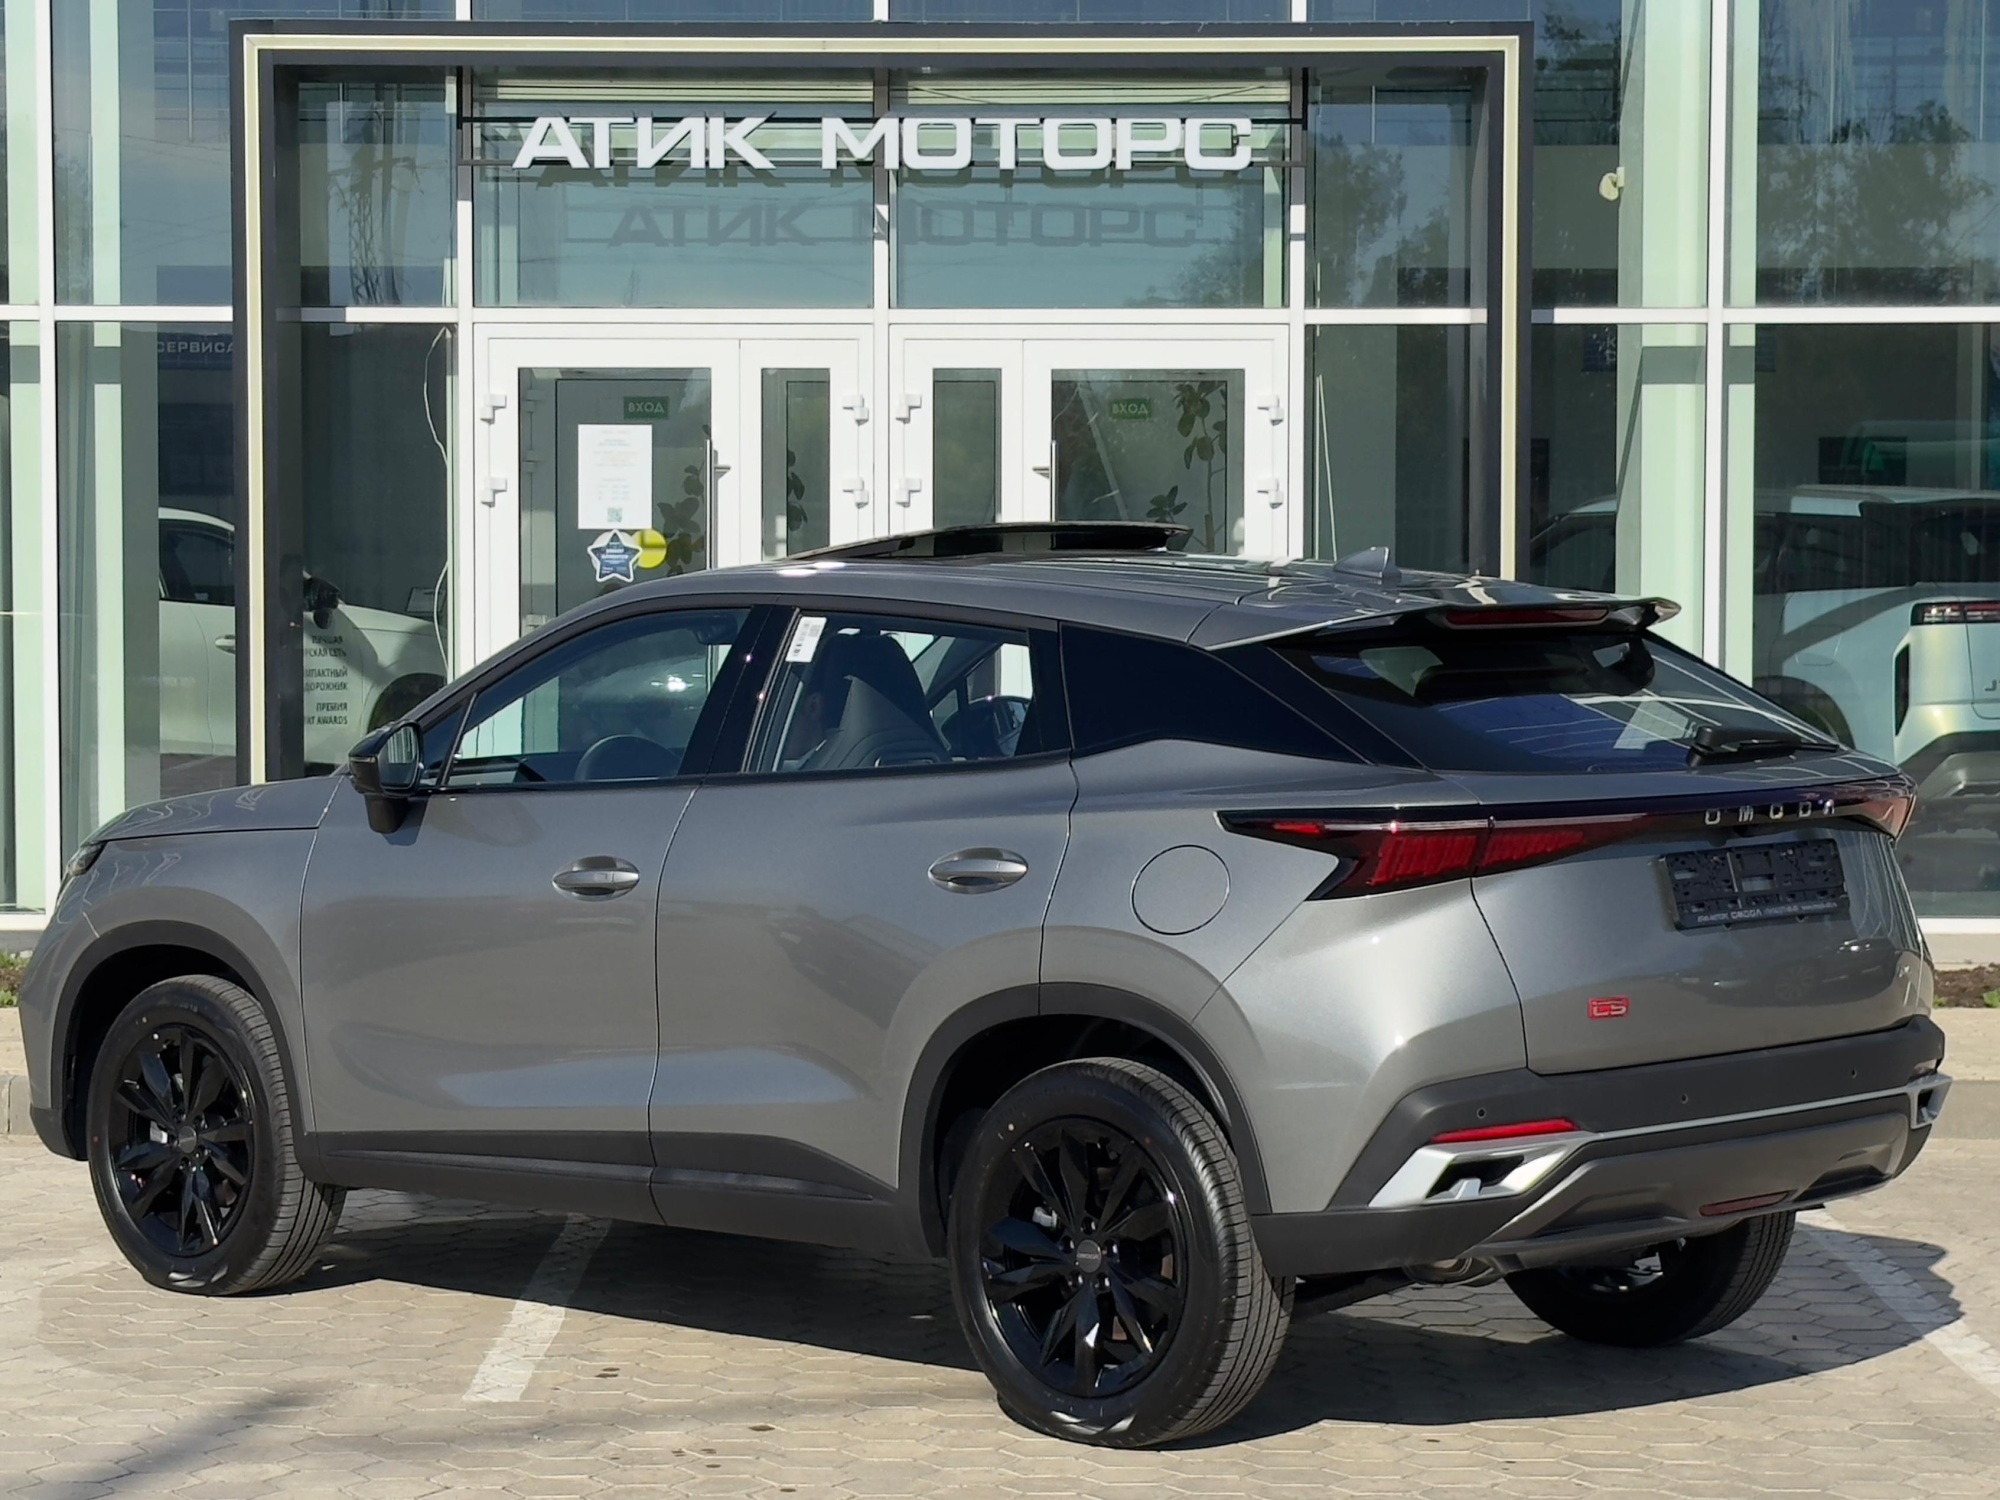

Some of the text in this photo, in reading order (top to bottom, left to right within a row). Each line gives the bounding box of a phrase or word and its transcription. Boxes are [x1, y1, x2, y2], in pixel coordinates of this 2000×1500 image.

[512, 116, 1252, 171] АТИК МОТОРС
[628, 401, 665, 414] ВХОД
[1112, 403, 1149, 415] ВХОД
